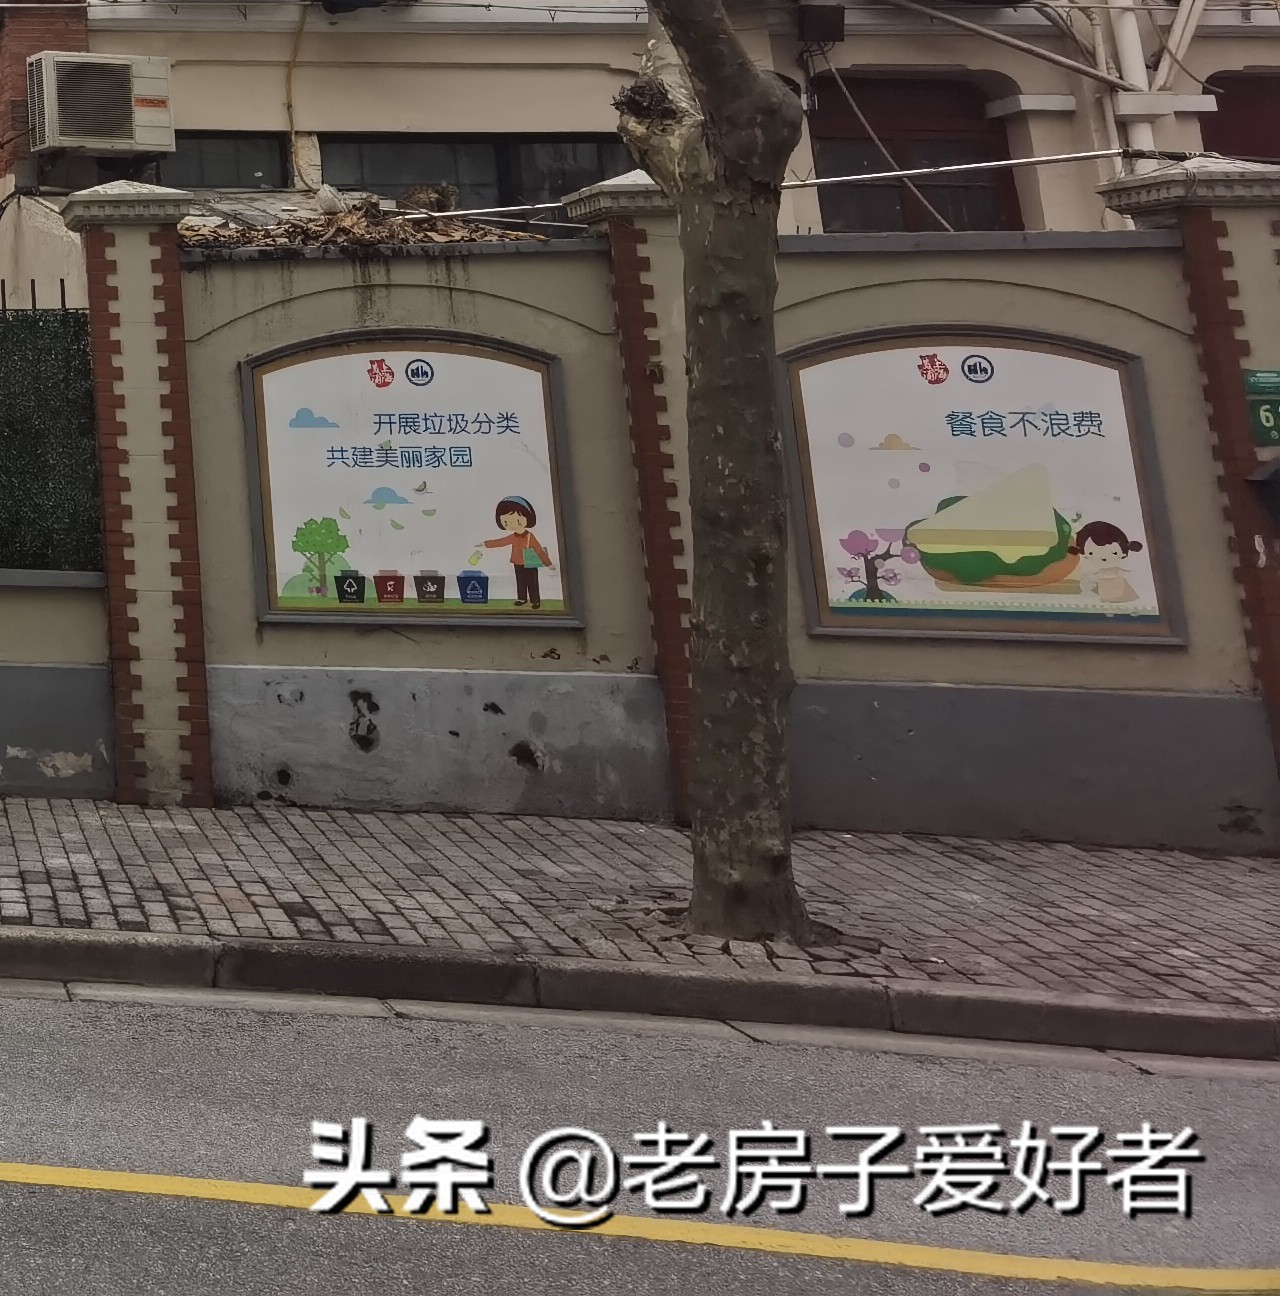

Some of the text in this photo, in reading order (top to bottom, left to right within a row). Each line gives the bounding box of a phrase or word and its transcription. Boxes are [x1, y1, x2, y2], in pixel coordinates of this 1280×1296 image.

[372, 411, 521, 436] 开展垃圾分类
[944, 410, 1106, 438] 餐食不浪费
[1260, 404, 1280, 428] 6
[326, 445, 473, 469] 共建美丽家园
